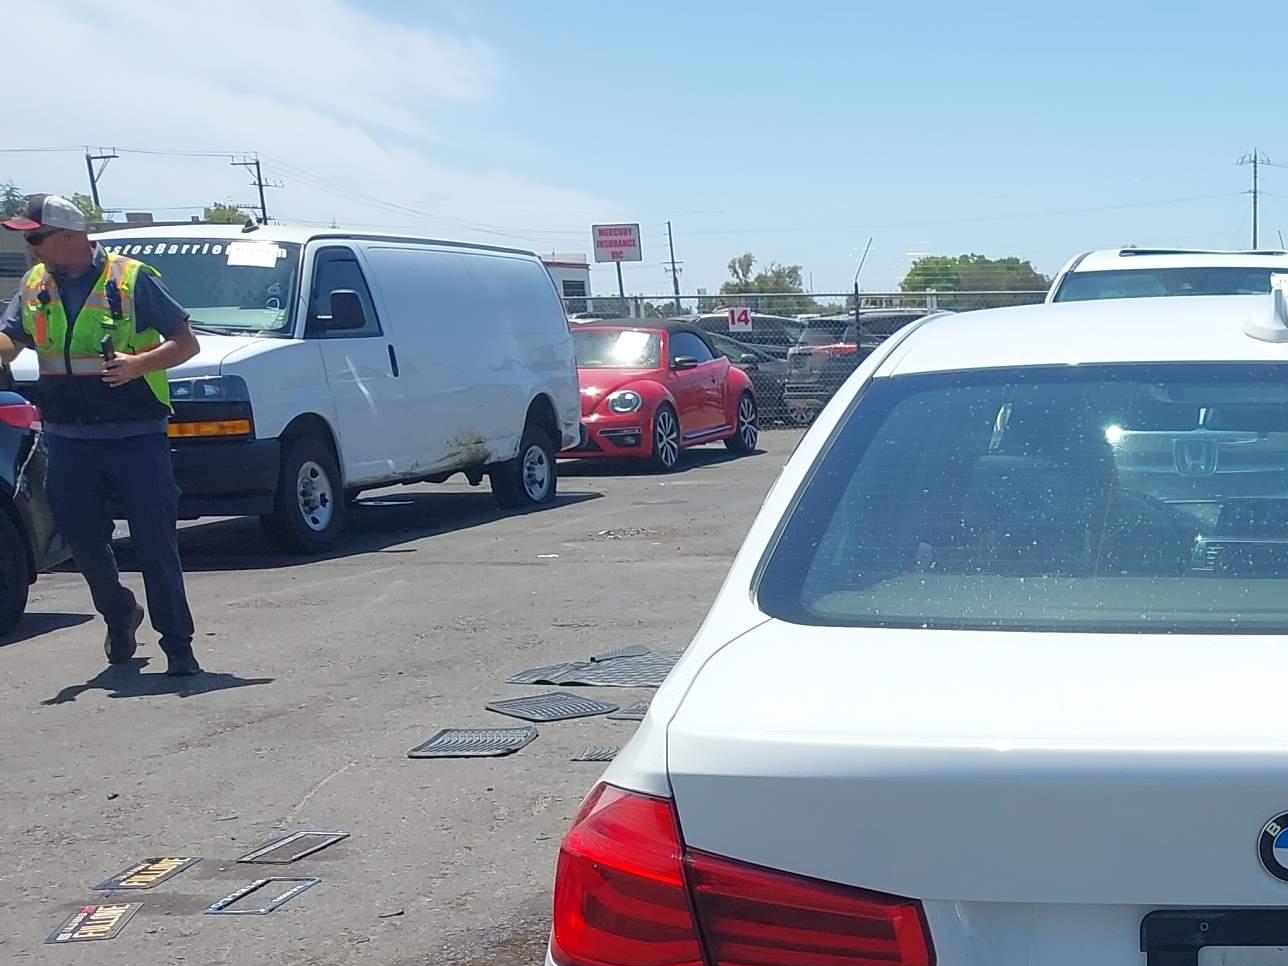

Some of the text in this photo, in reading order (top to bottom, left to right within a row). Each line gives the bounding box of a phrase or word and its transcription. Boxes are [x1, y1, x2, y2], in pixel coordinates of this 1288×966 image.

[598, 227, 632, 236] MERCURY
[596, 239, 637, 248] INSURANCE
[730, 309, 750, 325] 14
